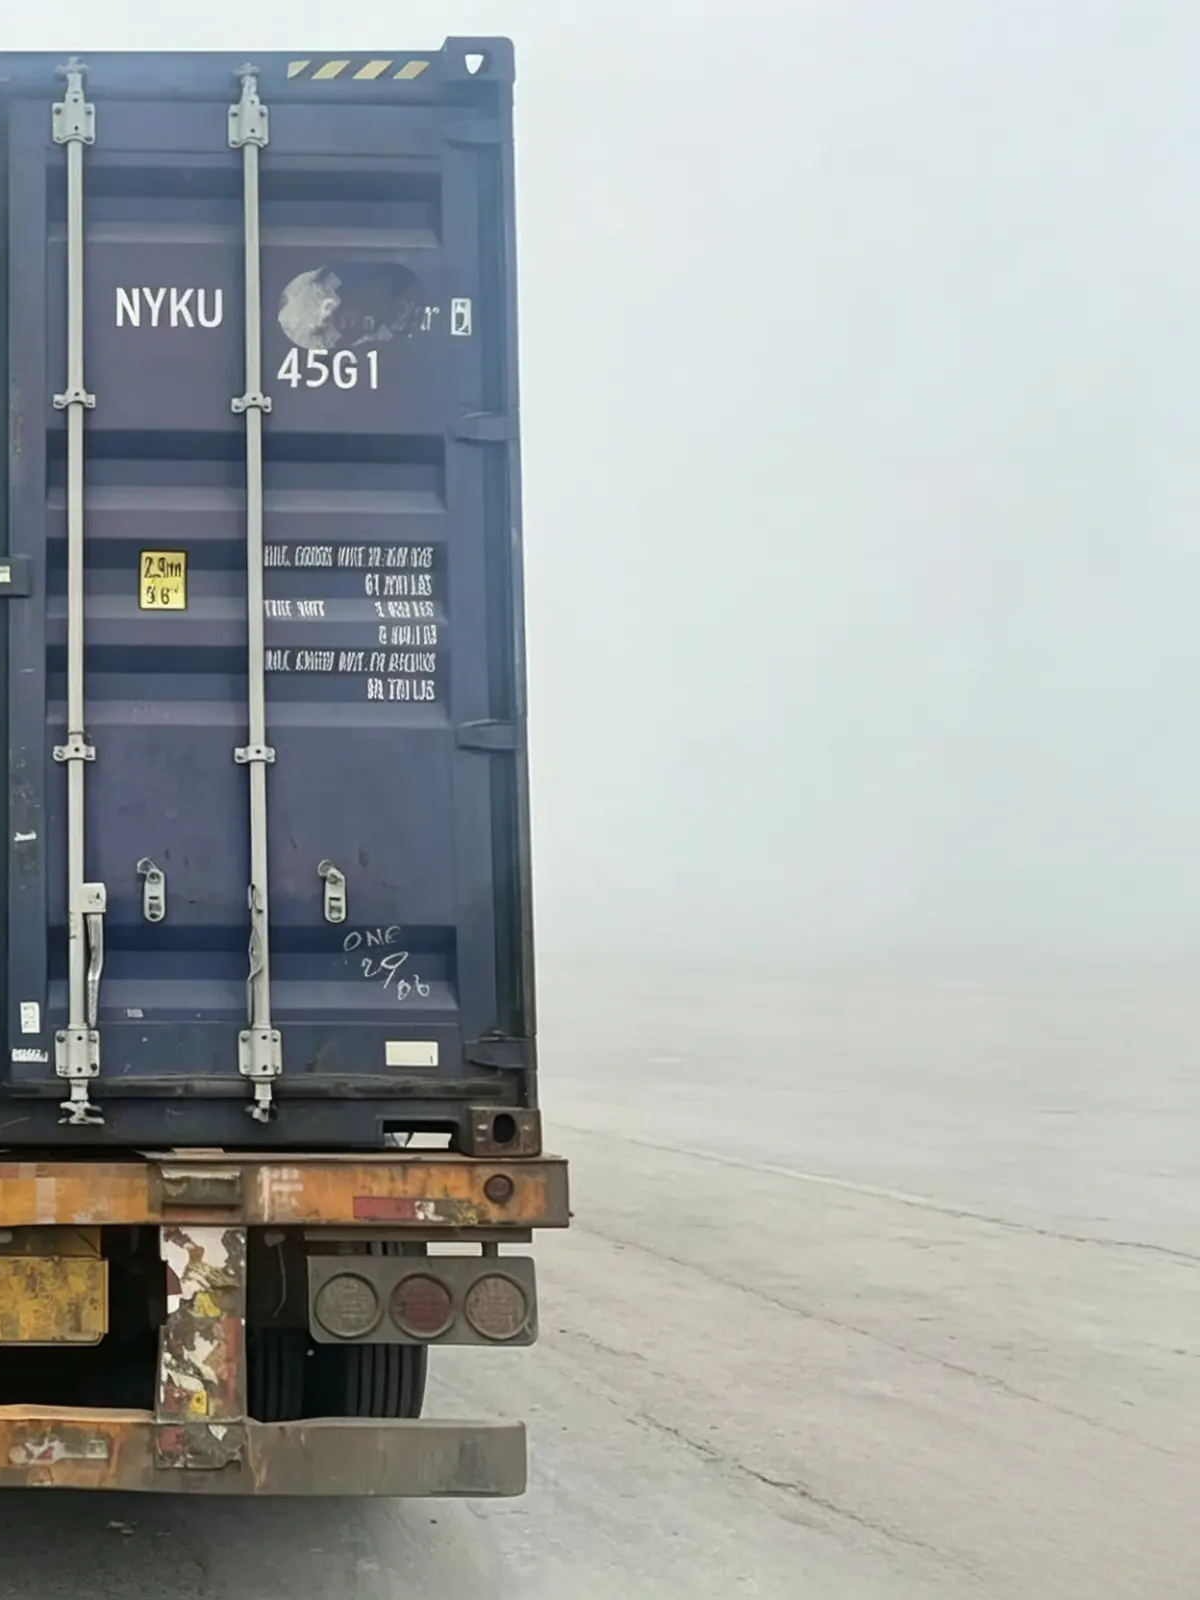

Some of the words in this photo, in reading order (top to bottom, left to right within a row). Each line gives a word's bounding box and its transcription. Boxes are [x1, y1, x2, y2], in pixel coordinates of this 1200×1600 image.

[116, 287, 223, 328] NYKU
[277, 347, 378, 389] 45G1
[343, 925, 400, 951] ONE
